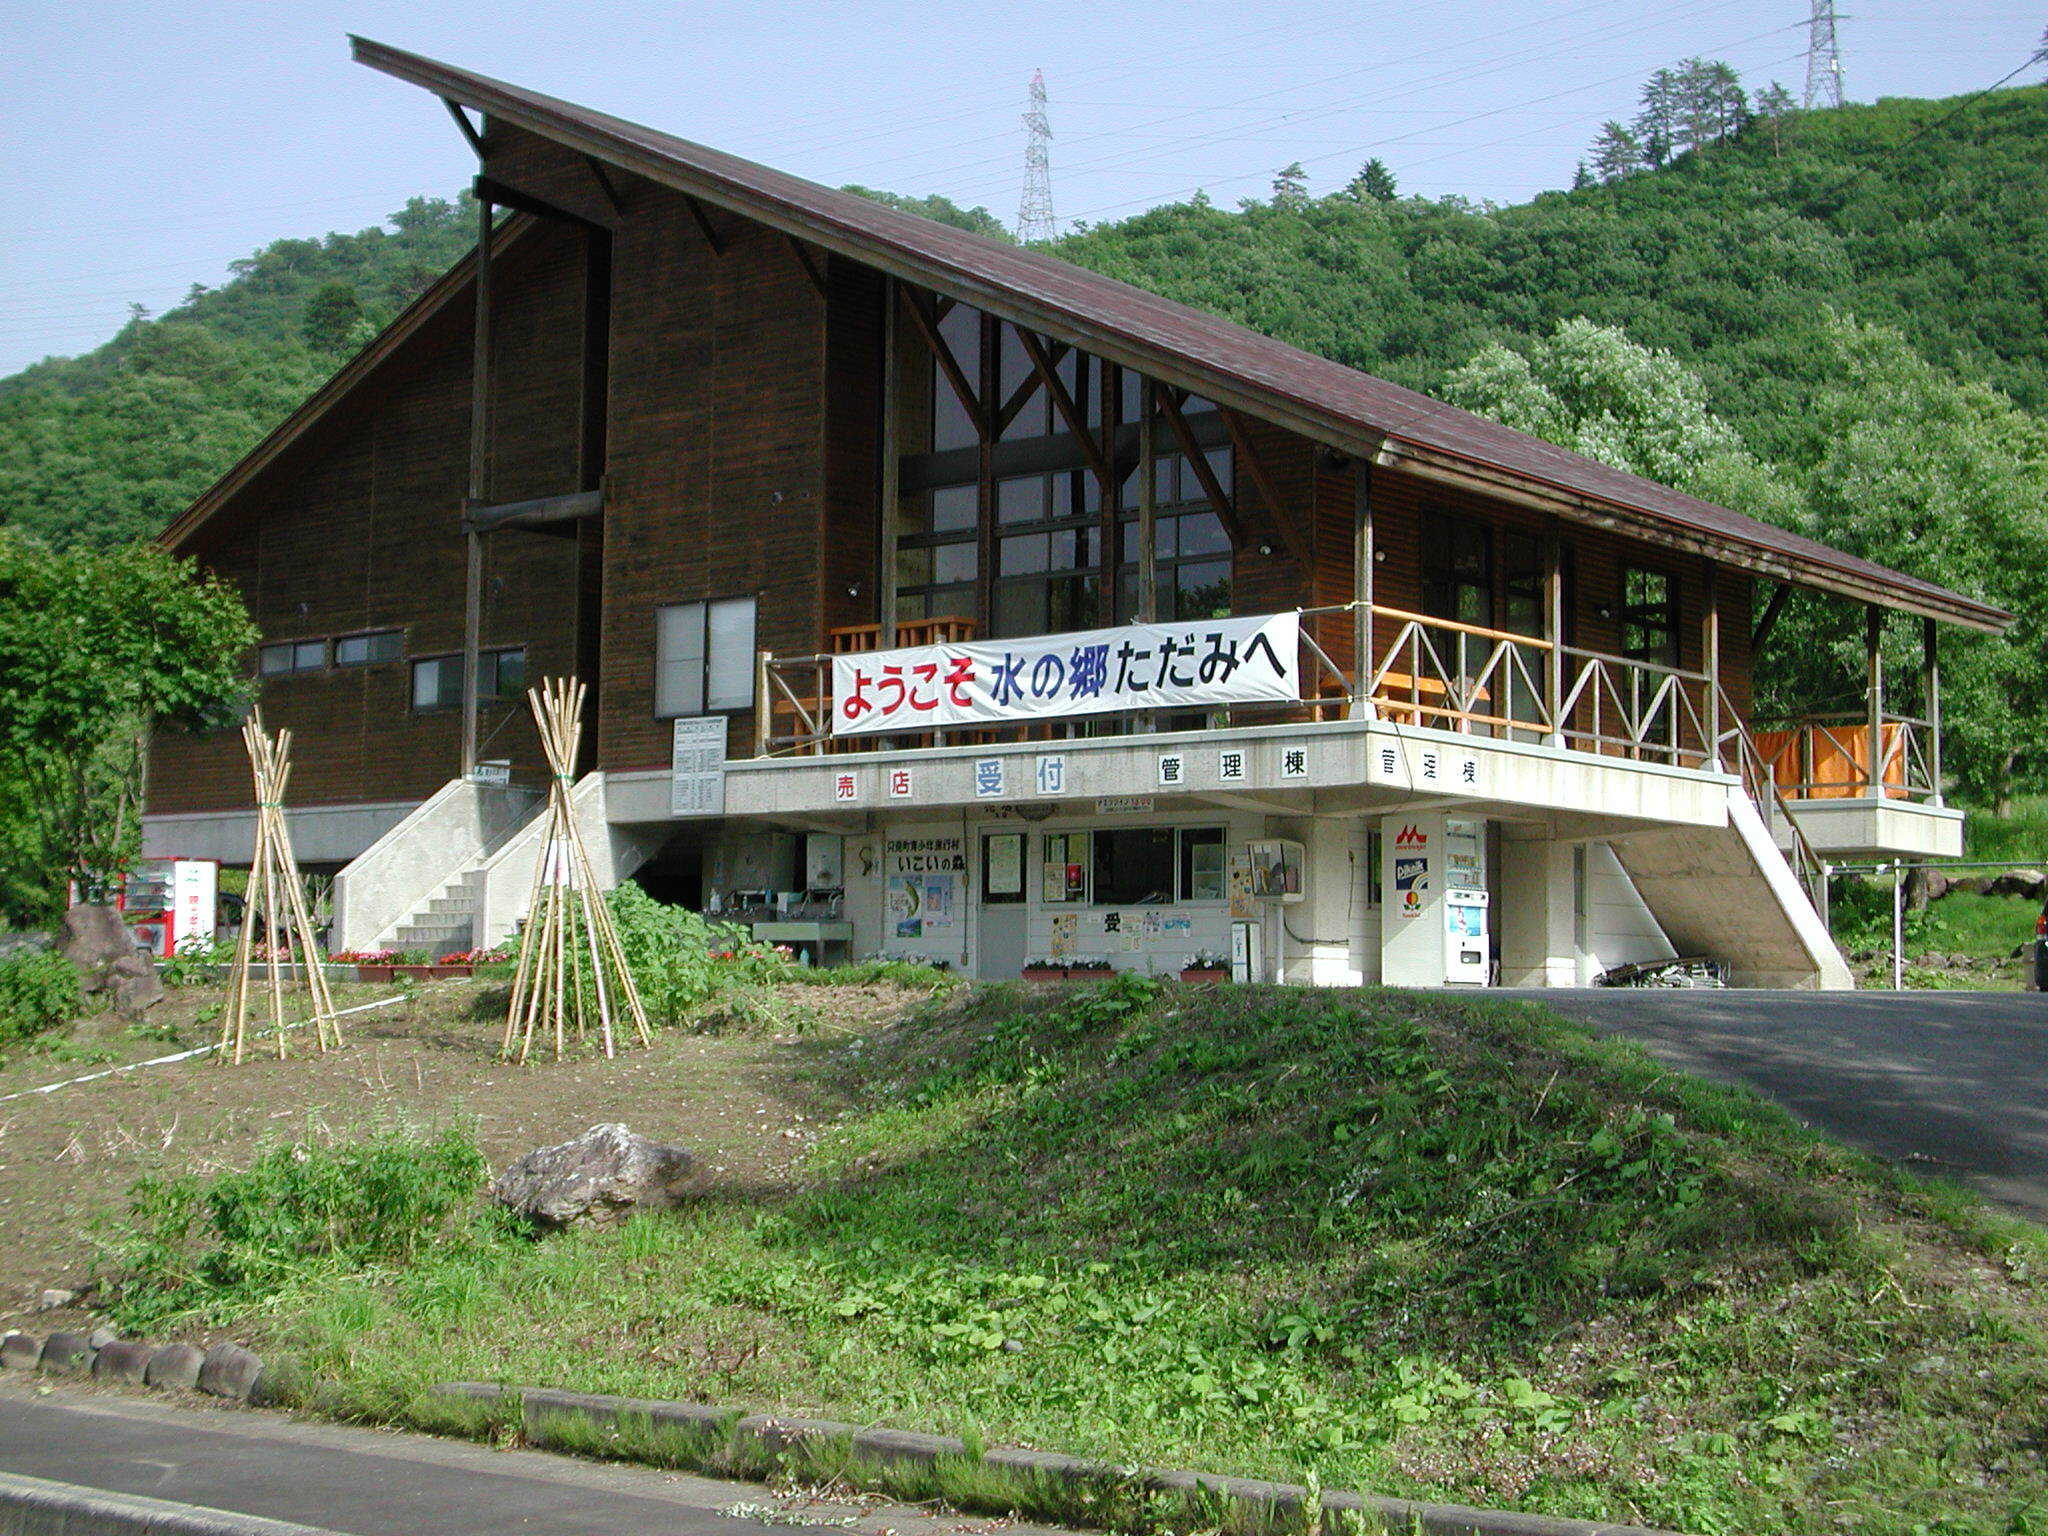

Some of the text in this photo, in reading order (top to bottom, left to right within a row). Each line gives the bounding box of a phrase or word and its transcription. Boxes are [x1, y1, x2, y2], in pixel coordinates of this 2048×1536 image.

[843, 632, 1287, 720] ようこそ 水の郷ただみへ
[837, 750, 1307, 799] 売店 受付 管理棟
[898, 854, 966, 872] いこいの森
